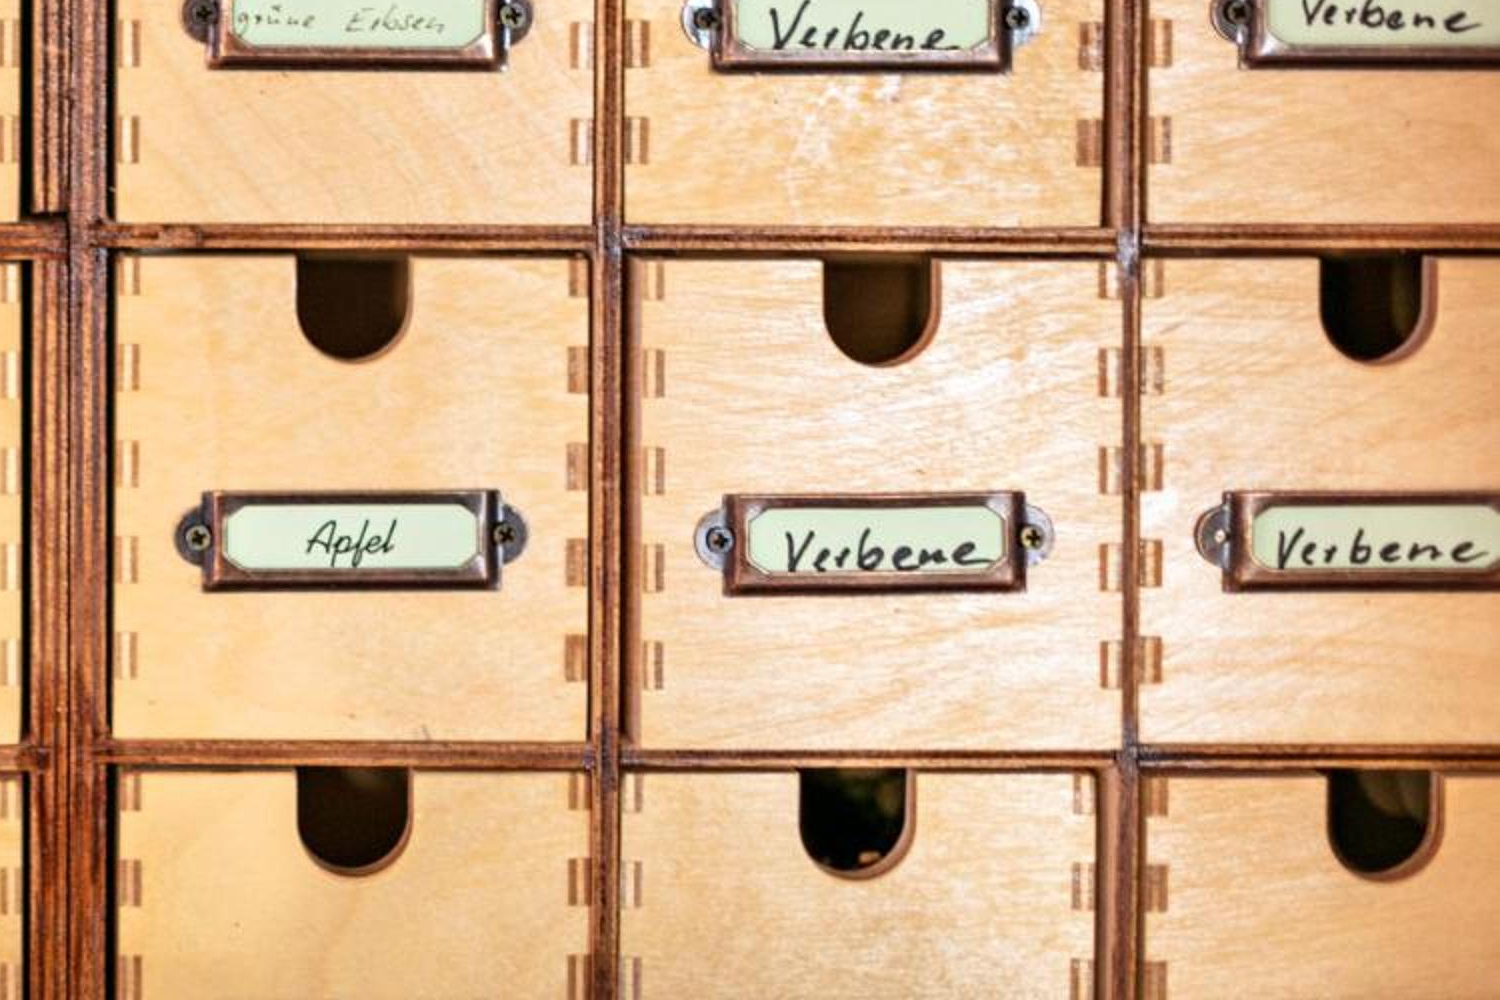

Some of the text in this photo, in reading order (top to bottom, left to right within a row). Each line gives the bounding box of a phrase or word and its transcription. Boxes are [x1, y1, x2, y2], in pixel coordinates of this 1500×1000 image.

[306, 518, 397, 568] Apfel
[785, 527, 992, 573] Verbene
[1277, 527, 1489, 571] Verbene
